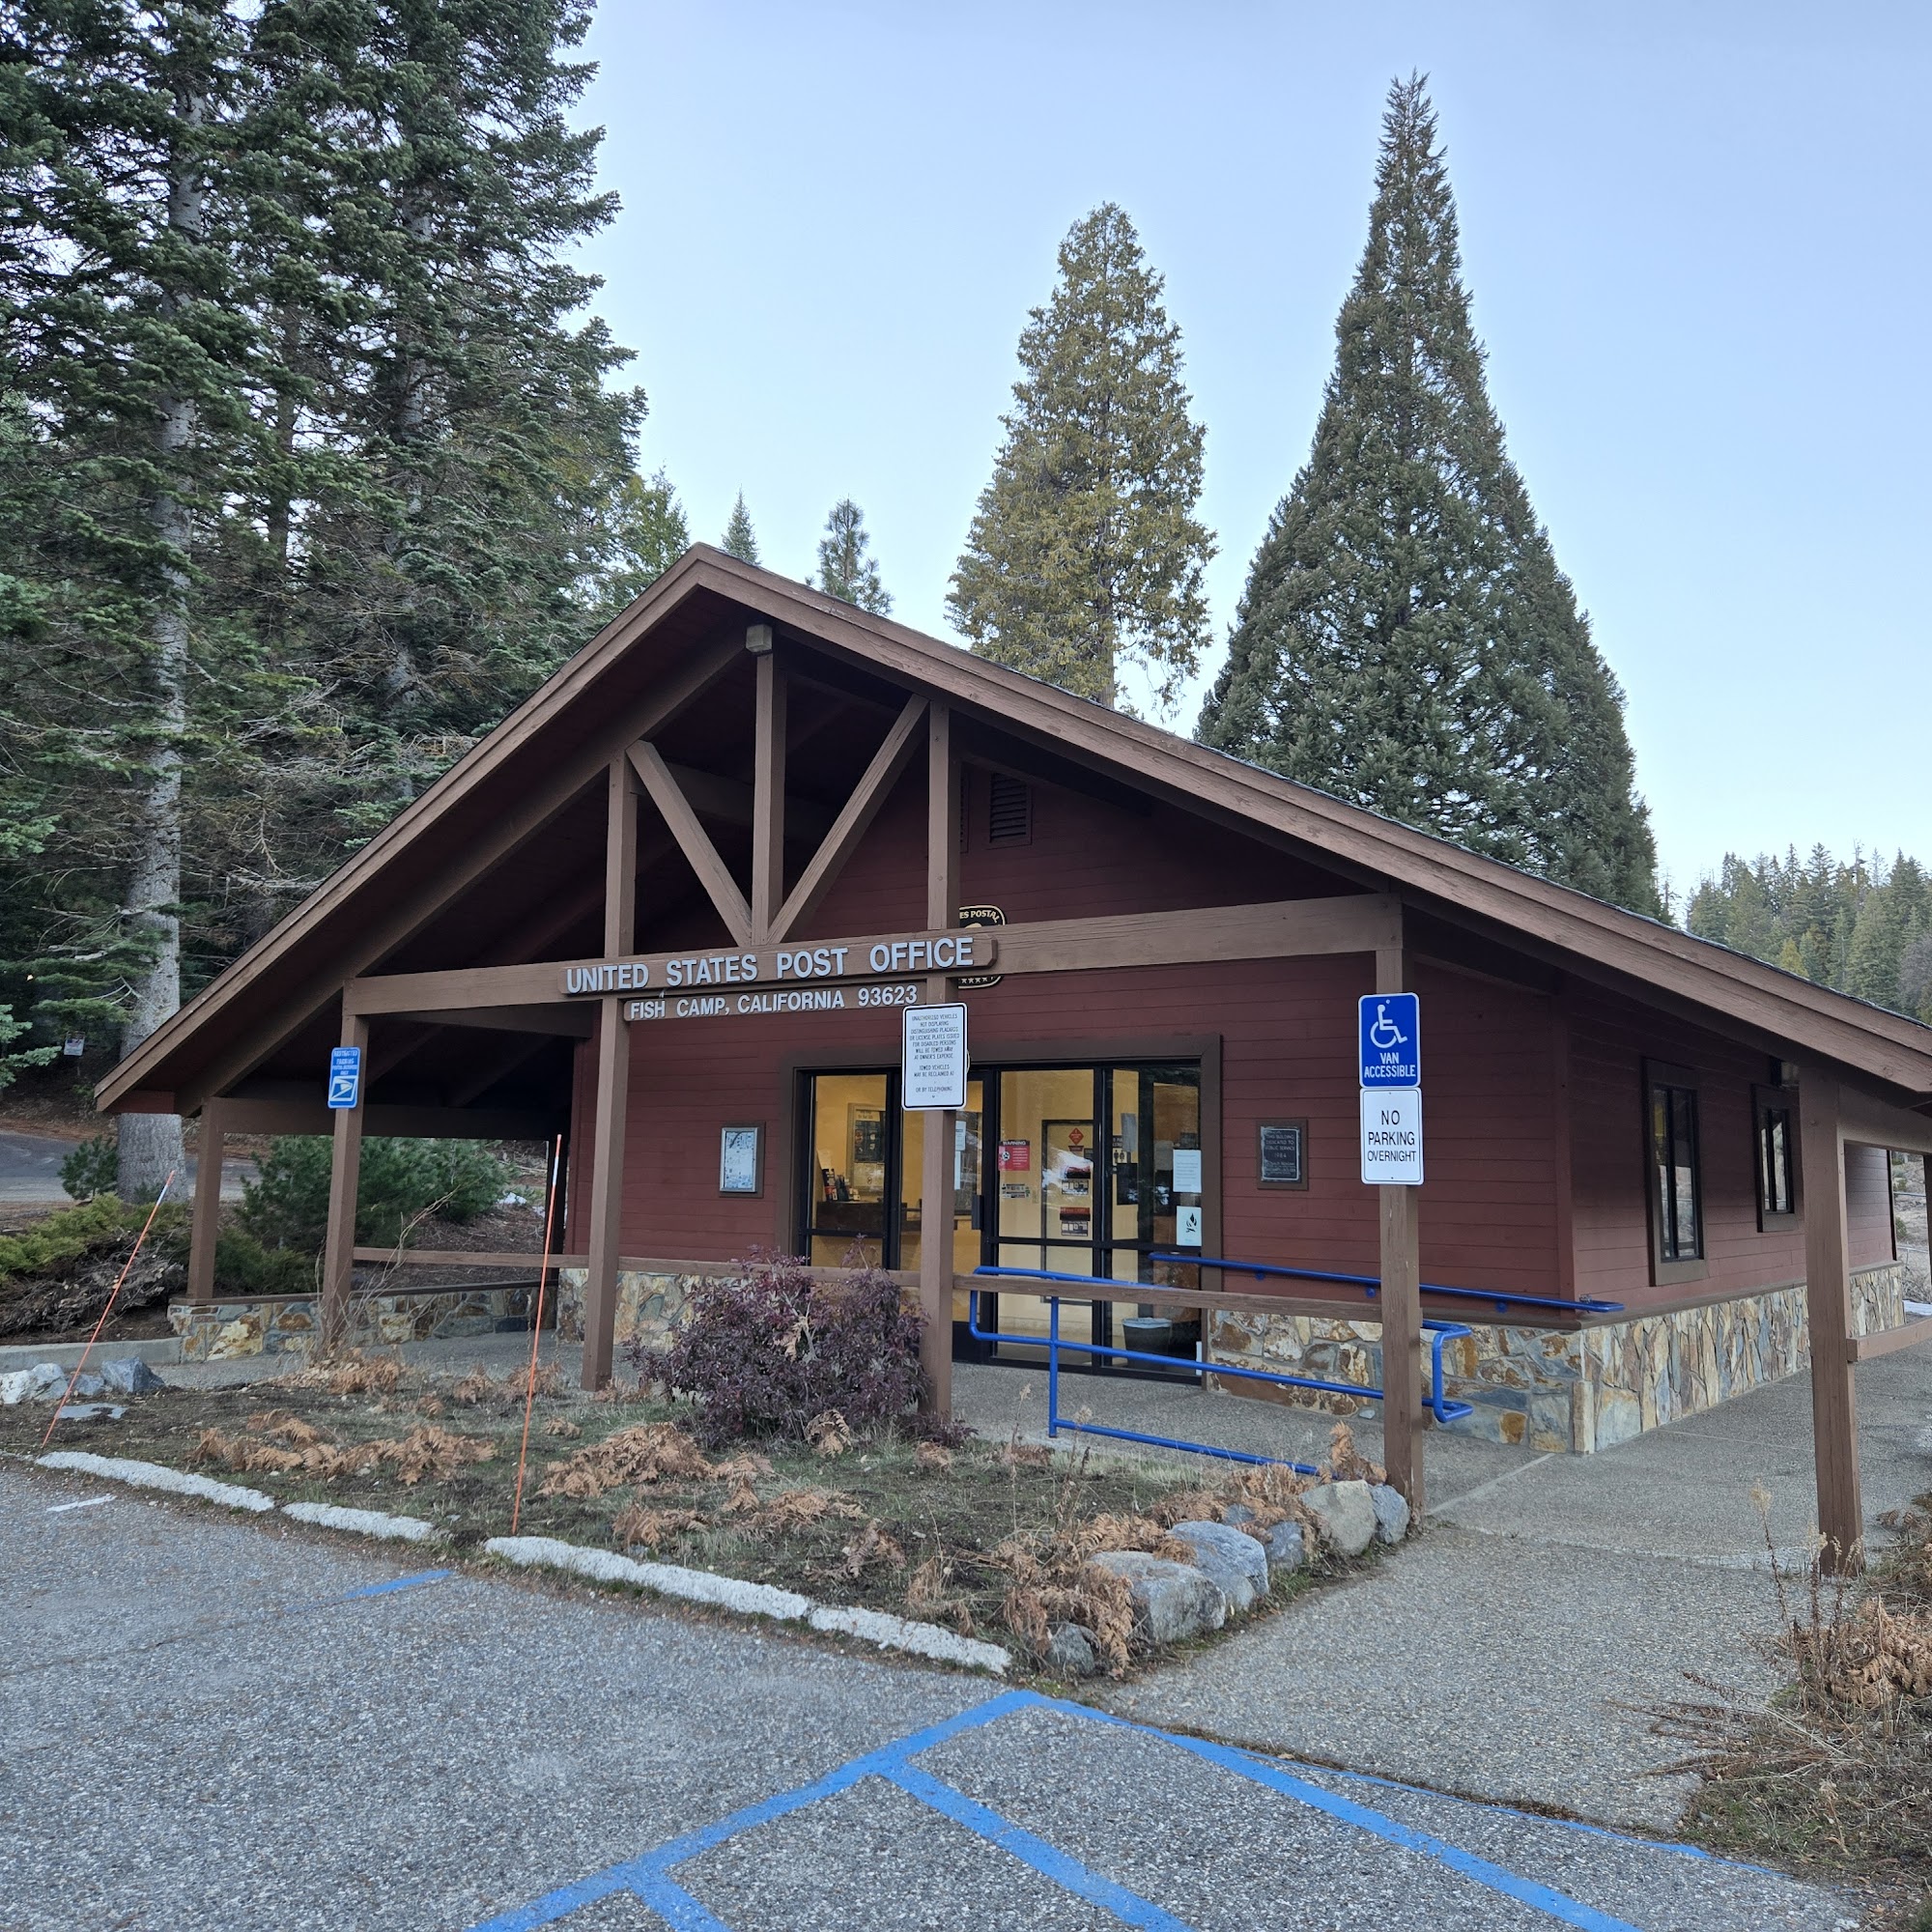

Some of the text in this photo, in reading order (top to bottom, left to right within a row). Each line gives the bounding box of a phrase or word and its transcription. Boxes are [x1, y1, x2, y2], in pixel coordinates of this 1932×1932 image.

[970, 910, 1000, 923] POSTAL
[566, 936, 974, 994] UNITED STATES POST OFFICE
[630, 984, 918, 1019] FISH CAMP, CALIFORNIA 93623
[1379, 1052, 1400, 1065] VAN
[1364, 1065, 1416, 1078] ACCESSIBLE
[1380, 1110, 1401, 1125] NO
[1368, 1131, 1415, 1146] PARKING
[1367, 1151, 1417, 1163] OVERNIGHT
